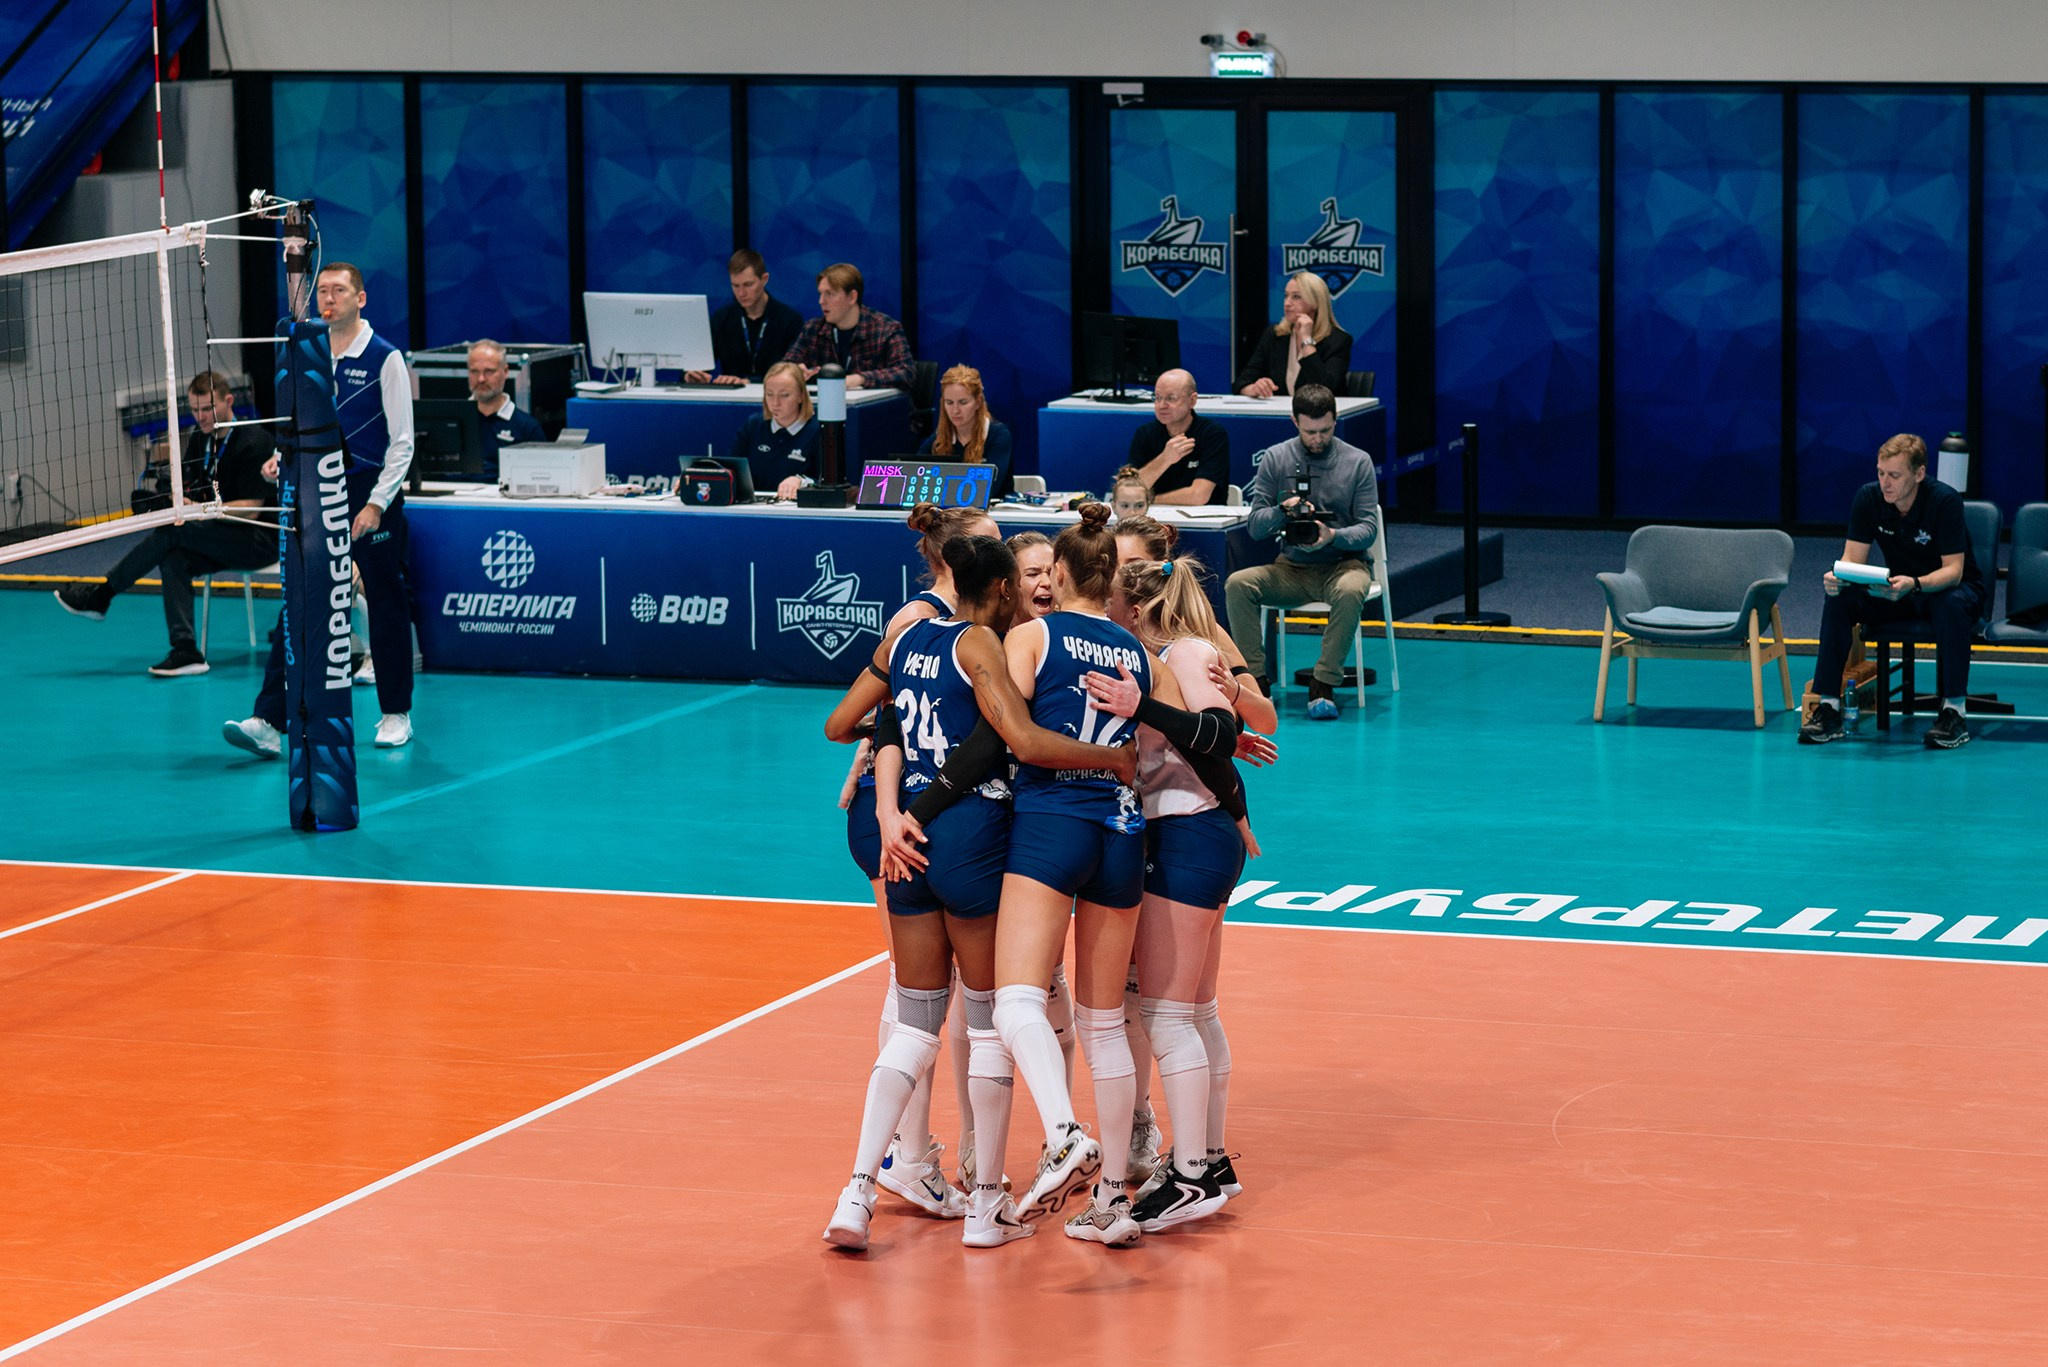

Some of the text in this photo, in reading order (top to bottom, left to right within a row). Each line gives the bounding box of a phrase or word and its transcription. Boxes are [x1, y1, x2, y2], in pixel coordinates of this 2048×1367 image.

[1126, 246, 1221, 267] КОРАБЕЛКА
[1287, 248, 1380, 269] КОРАБЕЛКА
[864, 465, 903, 476] MINSK
[876, 477, 889, 504] 1
[955, 480, 978, 507] 0
[317, 449, 353, 690] КОРАБЕЛКА
[442, 593, 577, 619] СУПЕРЛИГА
[659, 595, 729, 625] ВФВ
[783, 604, 878, 629] КОРАБЕЛКА
[459, 621, 555, 635] ЧЕМПИОНАТ РОССИИ
[1062, 636, 1142, 673] ЧЕРНЯЕВА
[895, 688, 949, 768] 24
[977, 1182, 998, 1191] rrea
